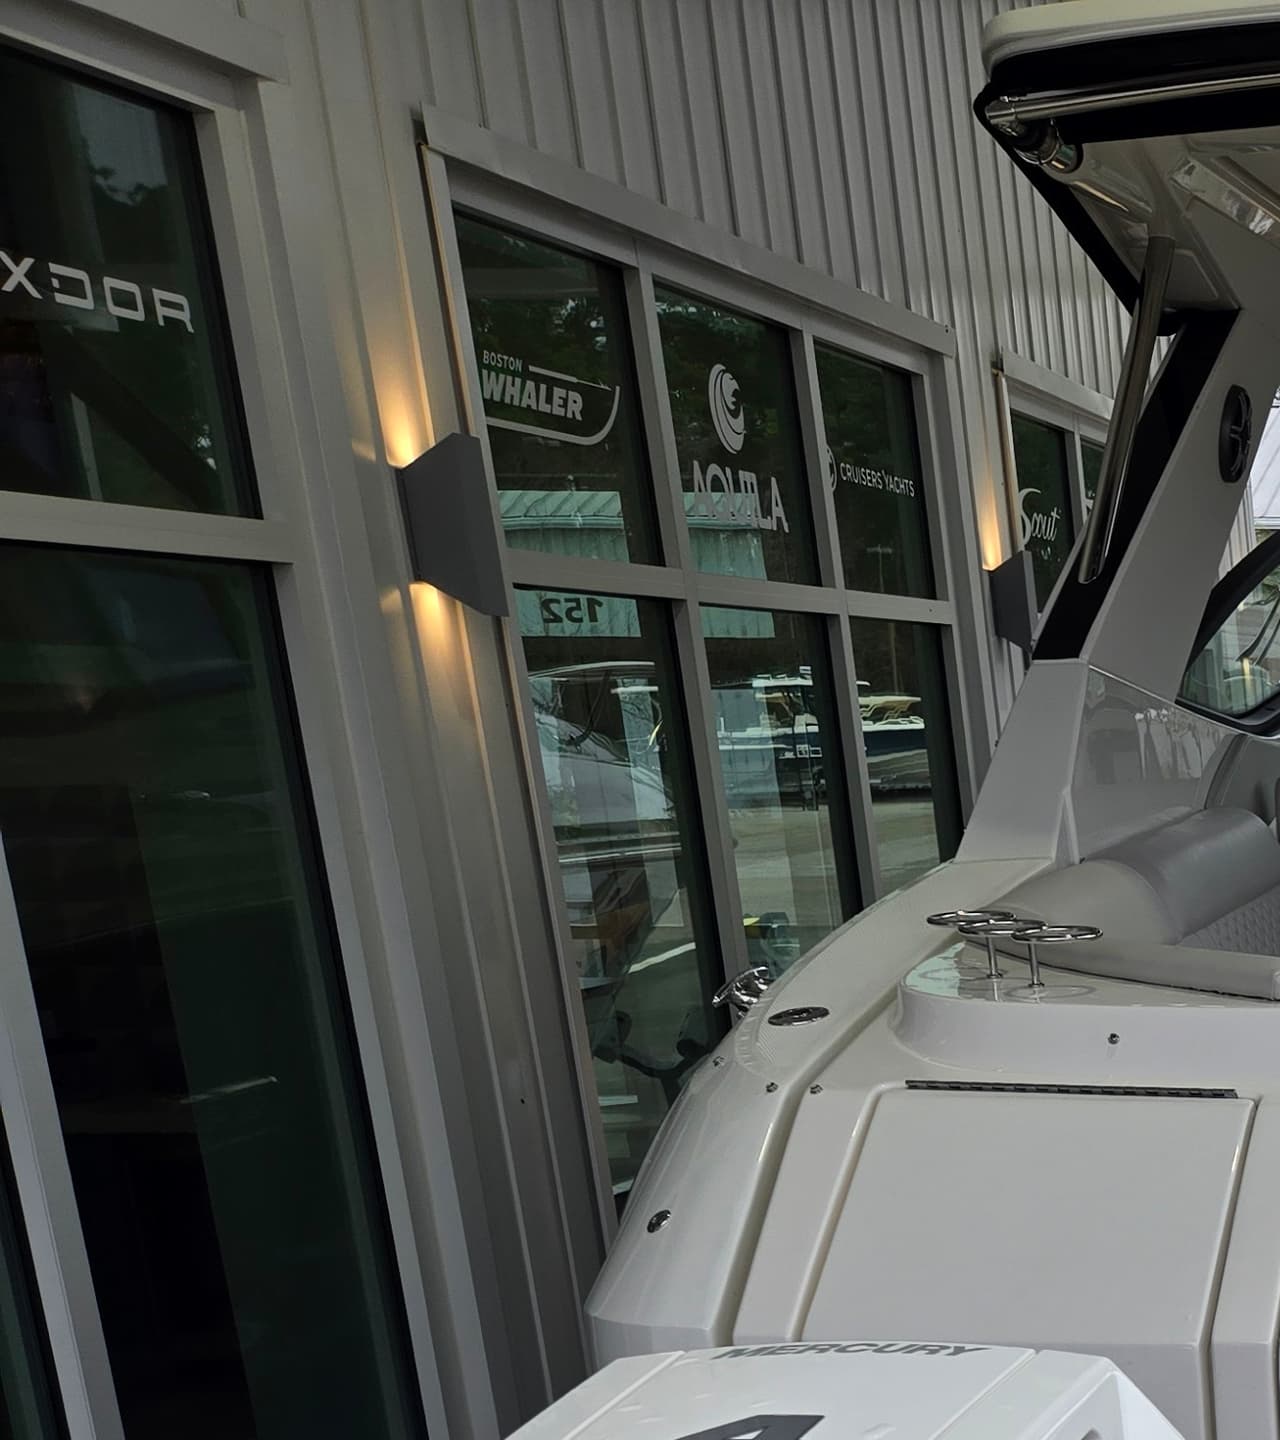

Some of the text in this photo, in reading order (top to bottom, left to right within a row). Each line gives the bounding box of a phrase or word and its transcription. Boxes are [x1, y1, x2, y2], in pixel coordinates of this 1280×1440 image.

[483, 350, 523, 372] BOSTON
[482, 369, 583, 421] WHALER
[693, 460, 789, 533] AQUILA
[840, 462, 915, 497] CRUISERS YACHTS
[710, 1342, 992, 1360] MERCURY
